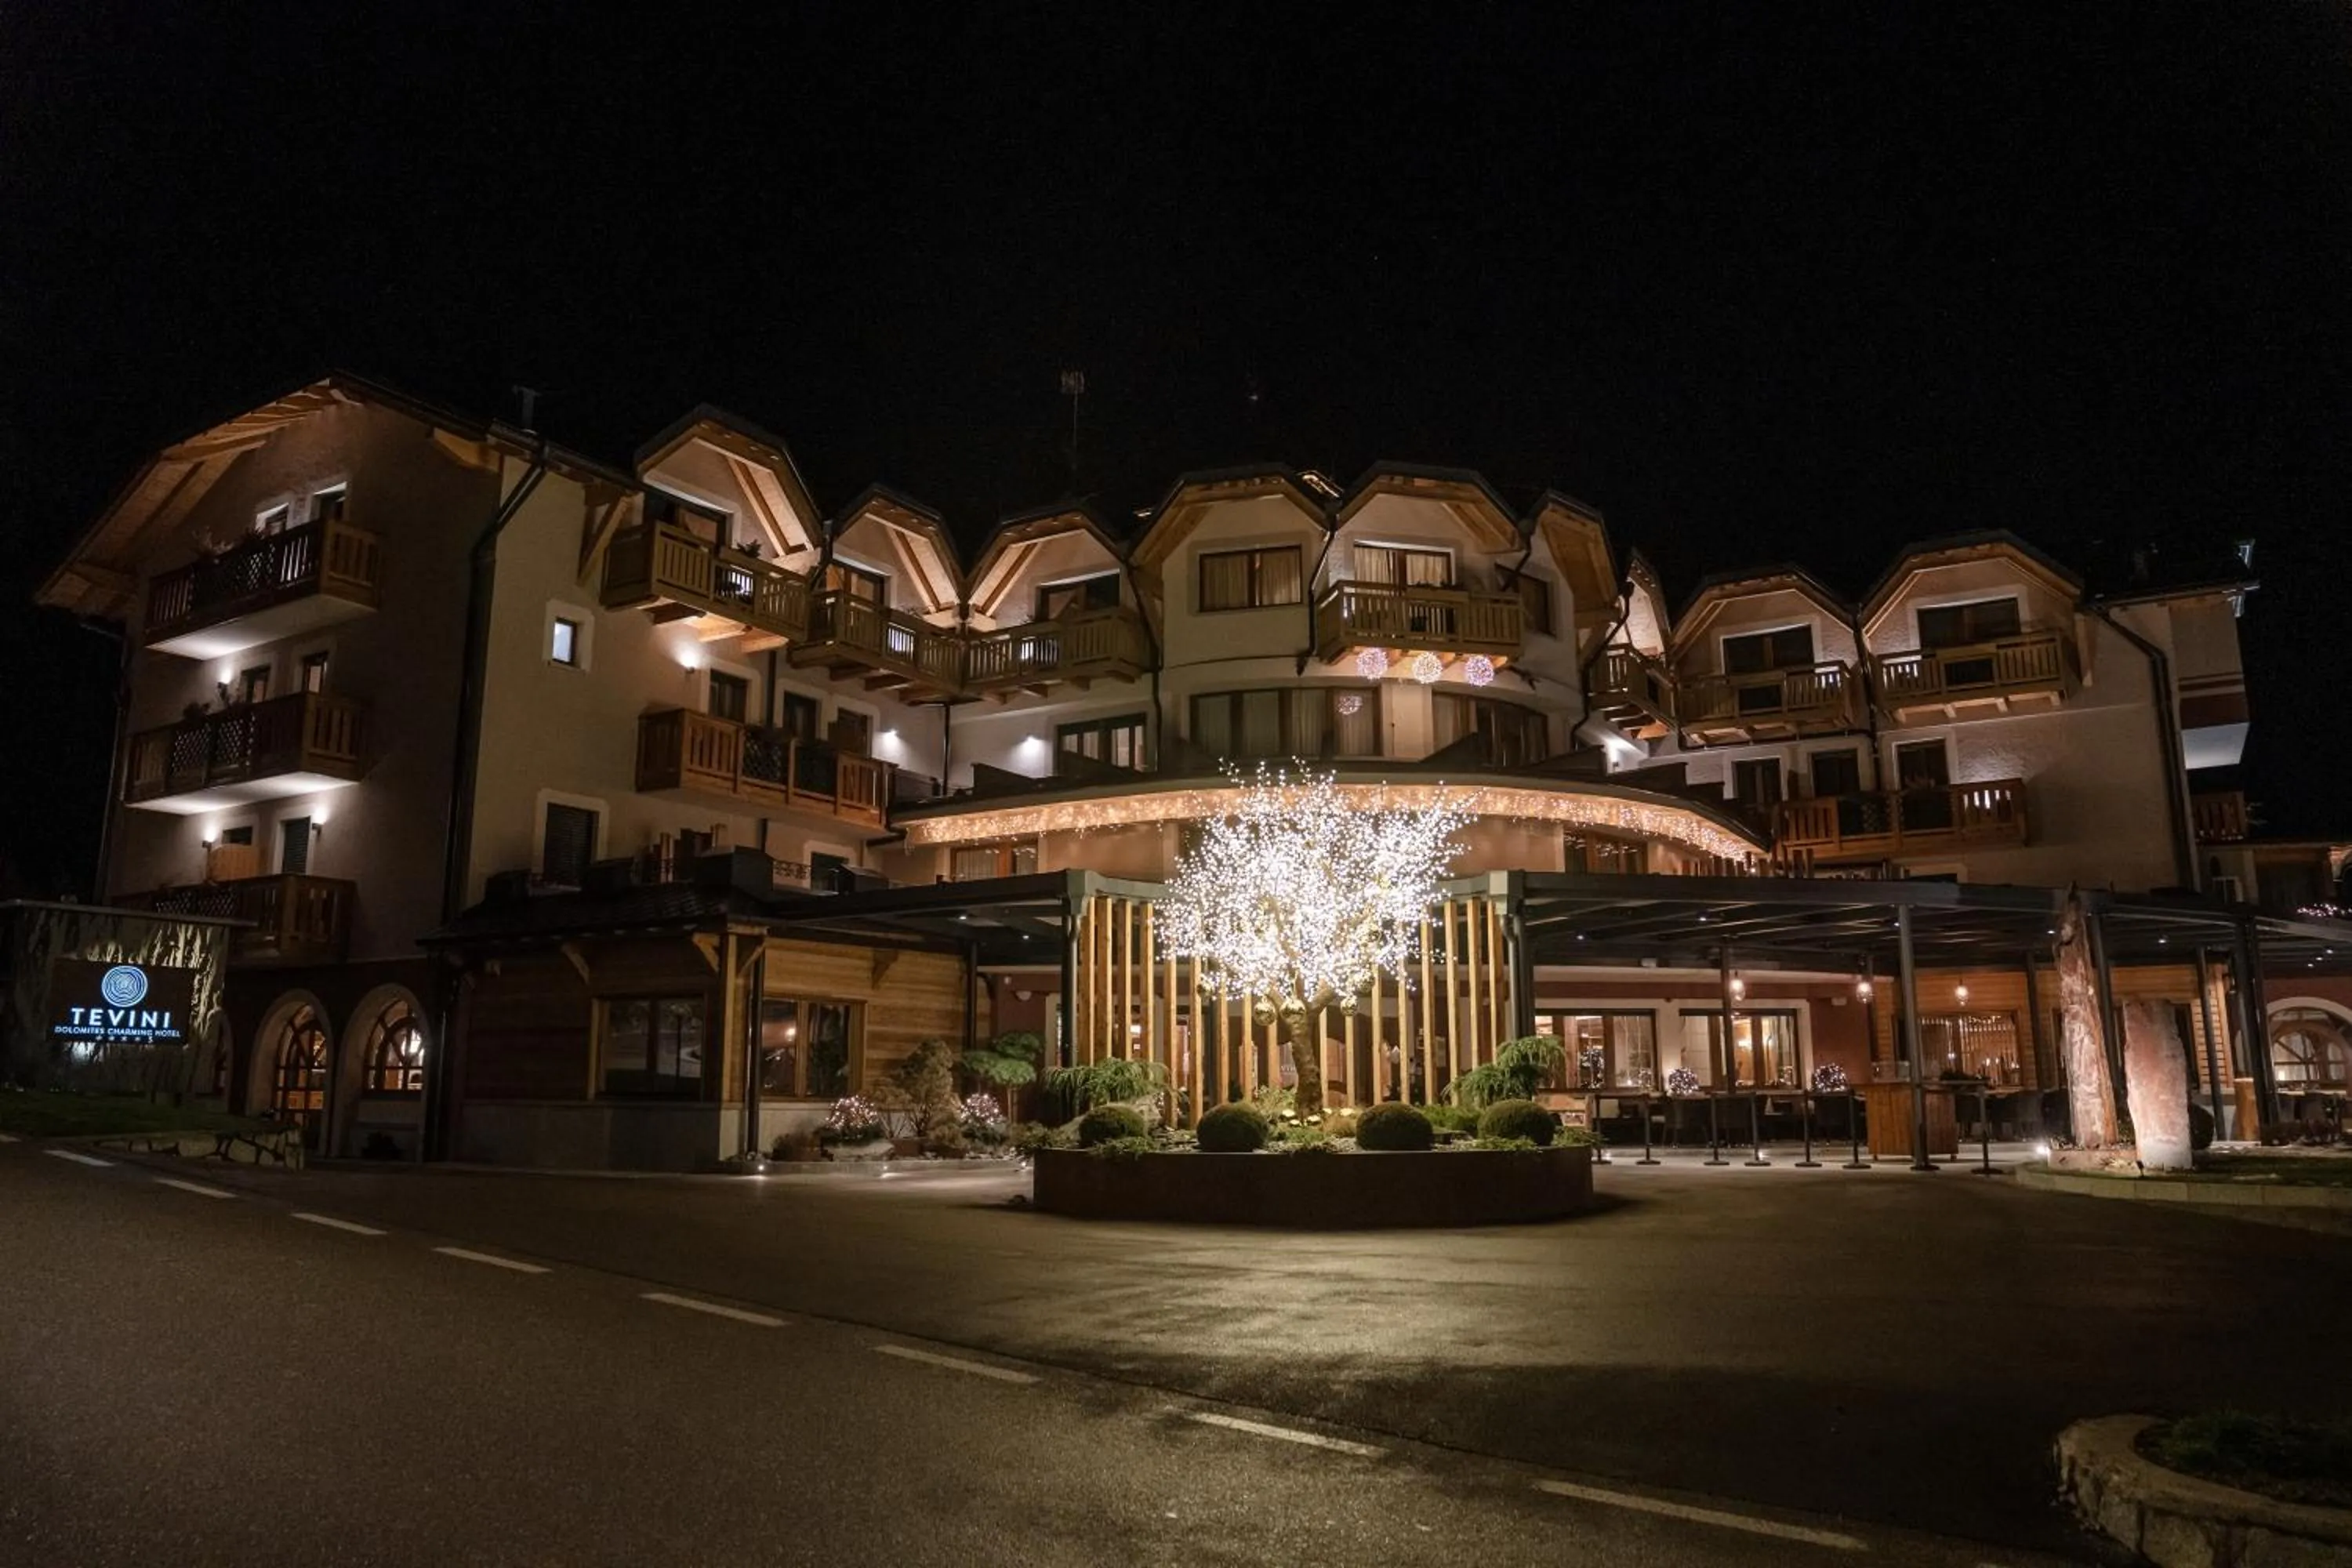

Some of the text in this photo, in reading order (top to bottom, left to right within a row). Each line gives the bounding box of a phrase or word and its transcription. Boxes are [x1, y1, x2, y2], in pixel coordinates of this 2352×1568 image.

[71, 1007, 171, 1029] TEVINI
[54, 1025, 181, 1038] DOLOMITES CHARMING HOTEL
